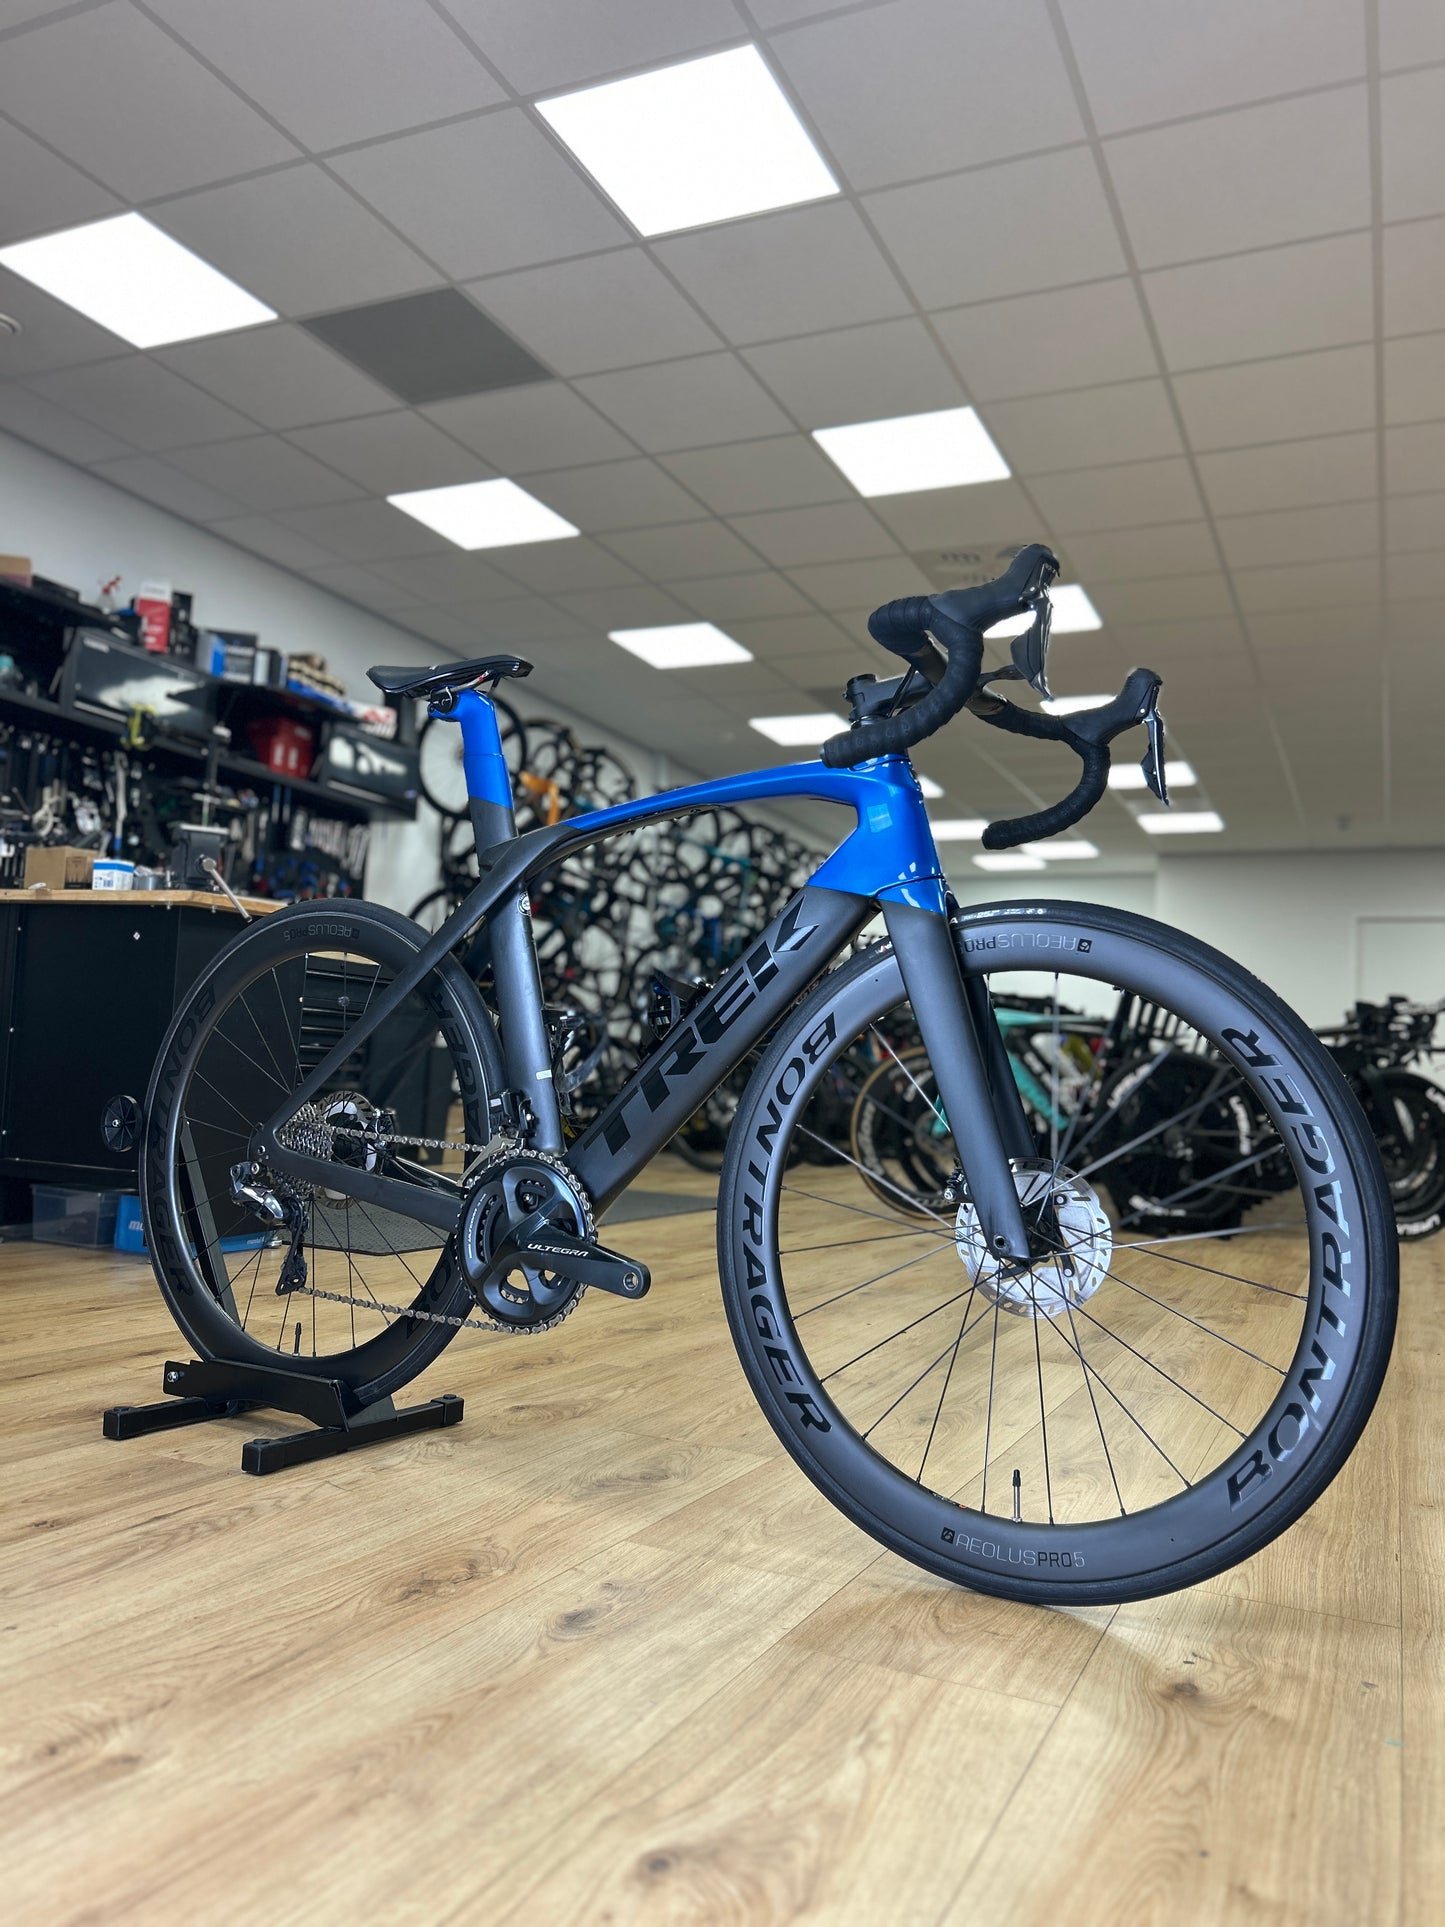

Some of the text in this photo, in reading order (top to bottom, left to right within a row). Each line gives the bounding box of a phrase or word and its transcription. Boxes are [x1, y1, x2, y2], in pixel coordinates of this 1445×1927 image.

[150, 984, 217, 1297] BONTRAGER
[583, 895, 820, 1157] TREK
[527, 1243, 589, 1257] ULTEGRA
[742, 1011, 837, 1434] BONTRAGER
[1220, 1027, 1351, 1512] BONTRAGER
